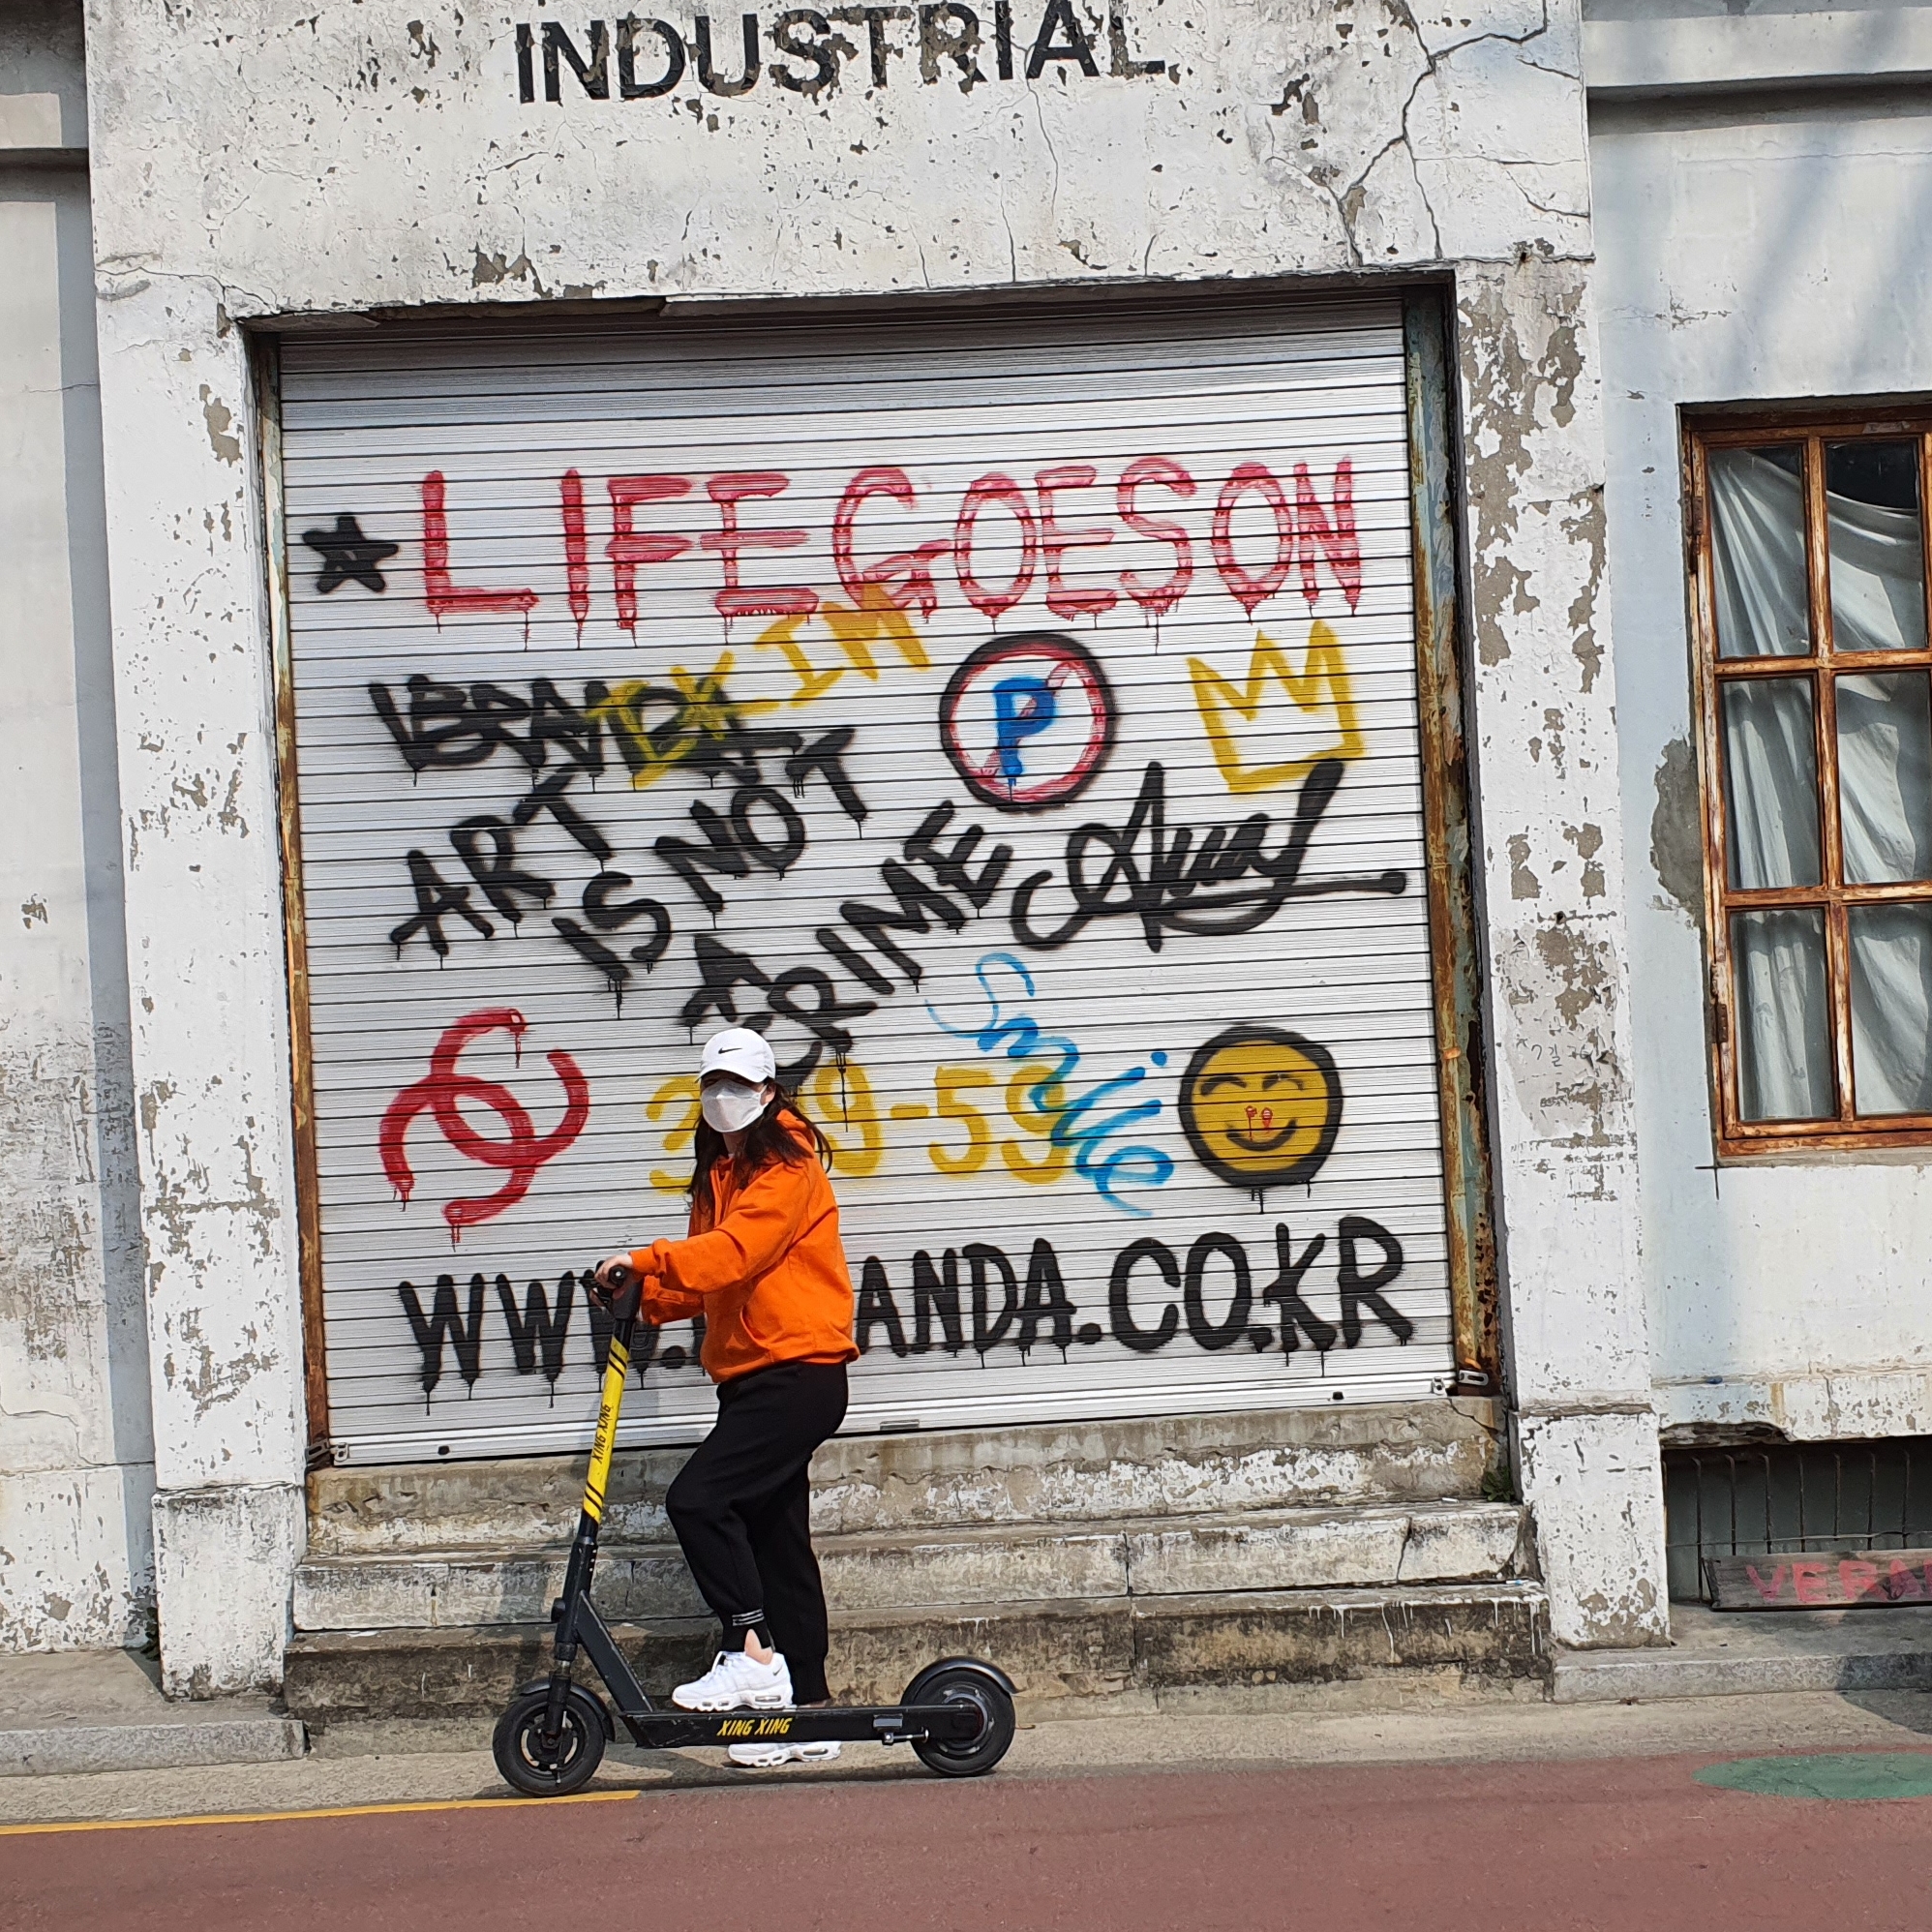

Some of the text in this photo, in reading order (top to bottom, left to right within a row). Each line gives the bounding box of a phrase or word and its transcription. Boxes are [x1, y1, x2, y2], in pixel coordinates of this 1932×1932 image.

[516, 0, 1165, 105] INDUSTRIAL
[420, 455, 1363, 631] LIFE GOES ON
[991, 676, 1058, 776] P
[389, 765, 615, 958] ART
[552, 728, 868, 985] IS NOT
[680, 934, 774, 1029] A
[1745, 1558, 1932, 1603] VERA
[716, 1717, 794, 1736] XING XING
